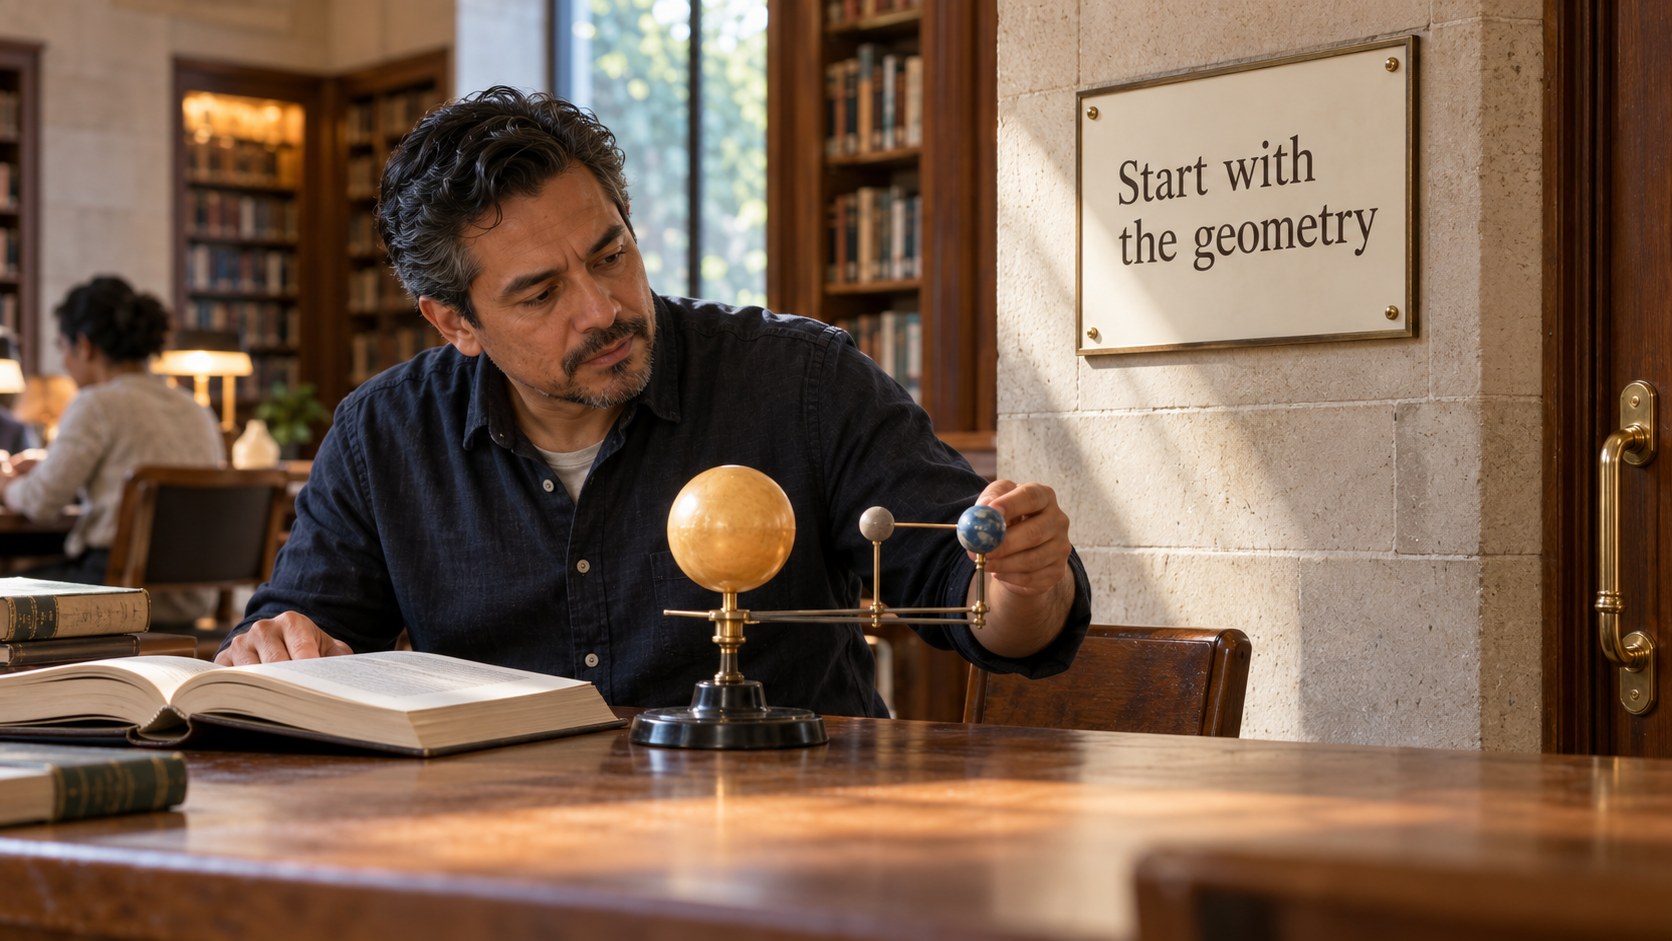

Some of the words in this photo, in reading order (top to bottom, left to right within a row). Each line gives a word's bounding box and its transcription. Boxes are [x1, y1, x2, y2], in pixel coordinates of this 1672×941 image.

[1118, 155, 1209, 205] Start
[1223, 134, 1316, 192] with
[1118, 218, 1178, 266] the
[1193, 204, 1379, 272] geometry
